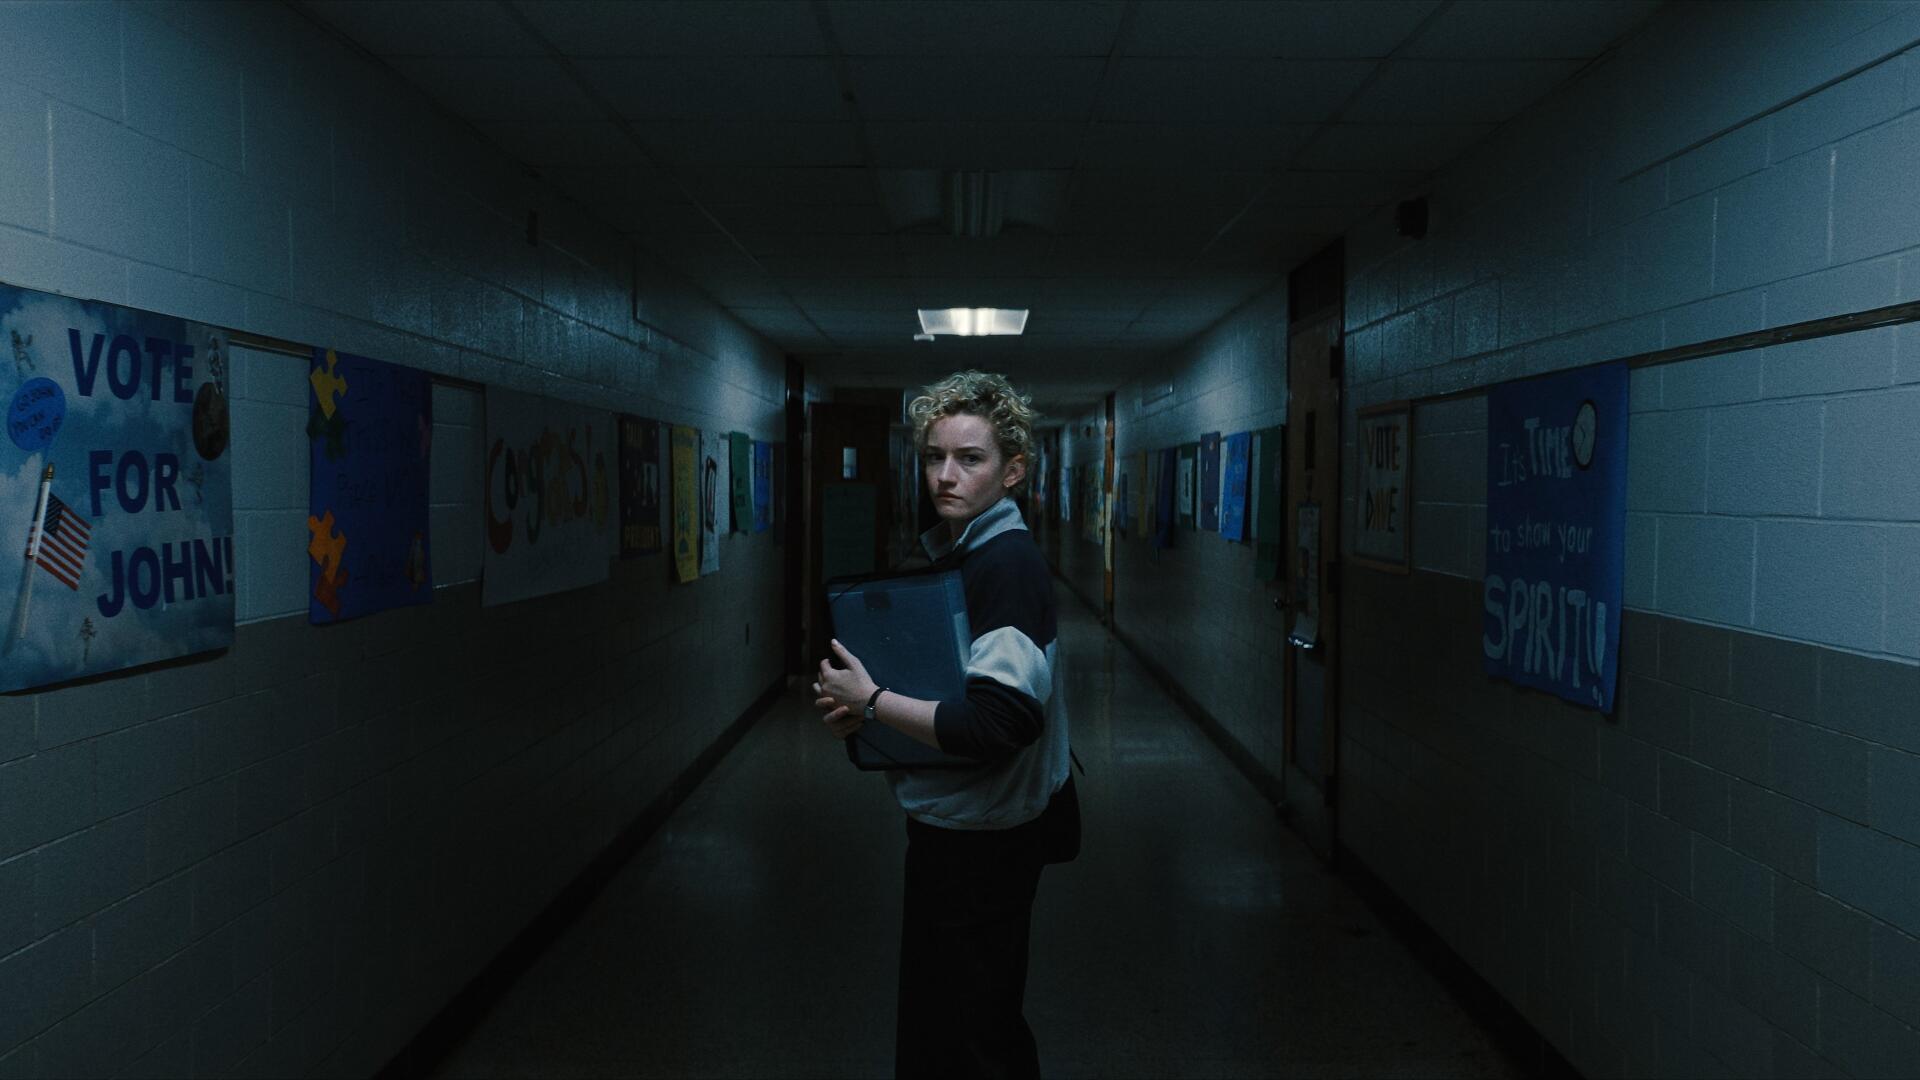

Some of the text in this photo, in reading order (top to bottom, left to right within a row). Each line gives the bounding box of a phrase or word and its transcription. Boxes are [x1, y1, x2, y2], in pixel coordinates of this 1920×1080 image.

[69, 328, 194, 403] VOTE
[1366, 423, 1400, 471] VOTE
[1524, 417, 1572, 478] TIME
[90, 450, 181, 516] FOR
[1490, 513, 1593, 564] to show your
[97, 537, 233, 618] JOHN!
